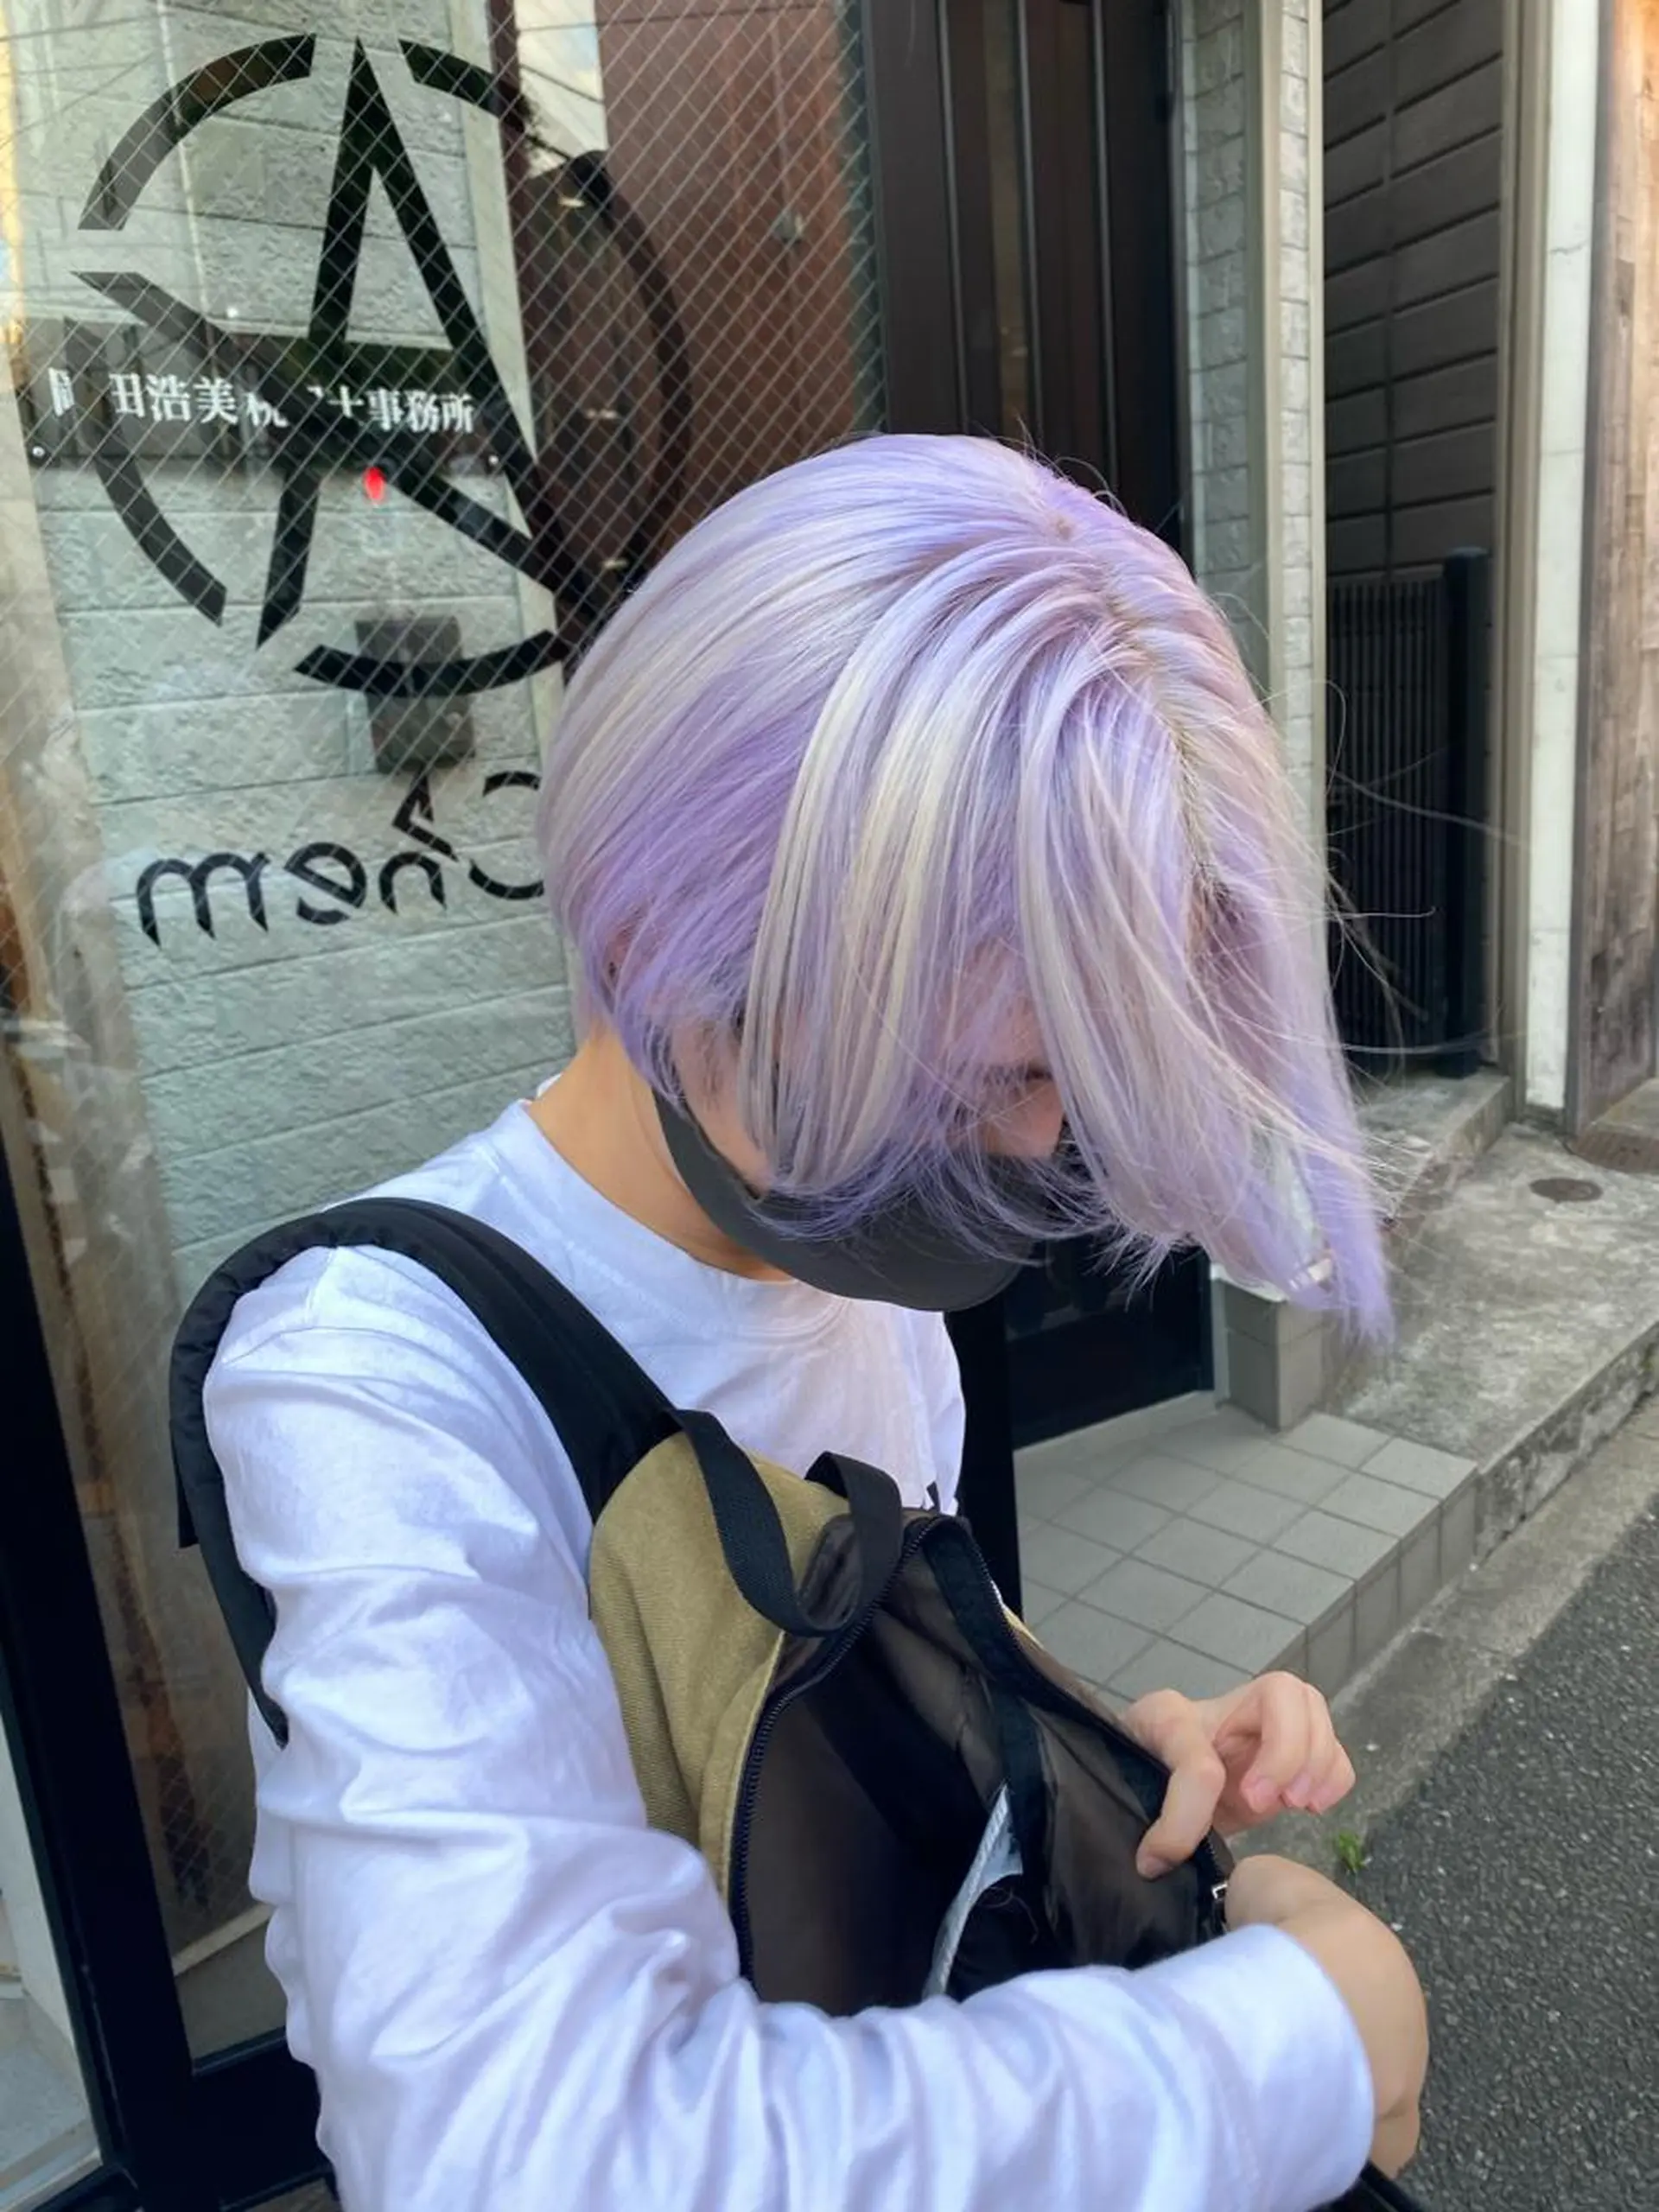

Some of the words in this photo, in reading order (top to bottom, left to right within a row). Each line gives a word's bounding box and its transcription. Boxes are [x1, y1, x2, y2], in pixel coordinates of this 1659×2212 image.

[48, 366, 474, 432] 田浩美税士事務所
